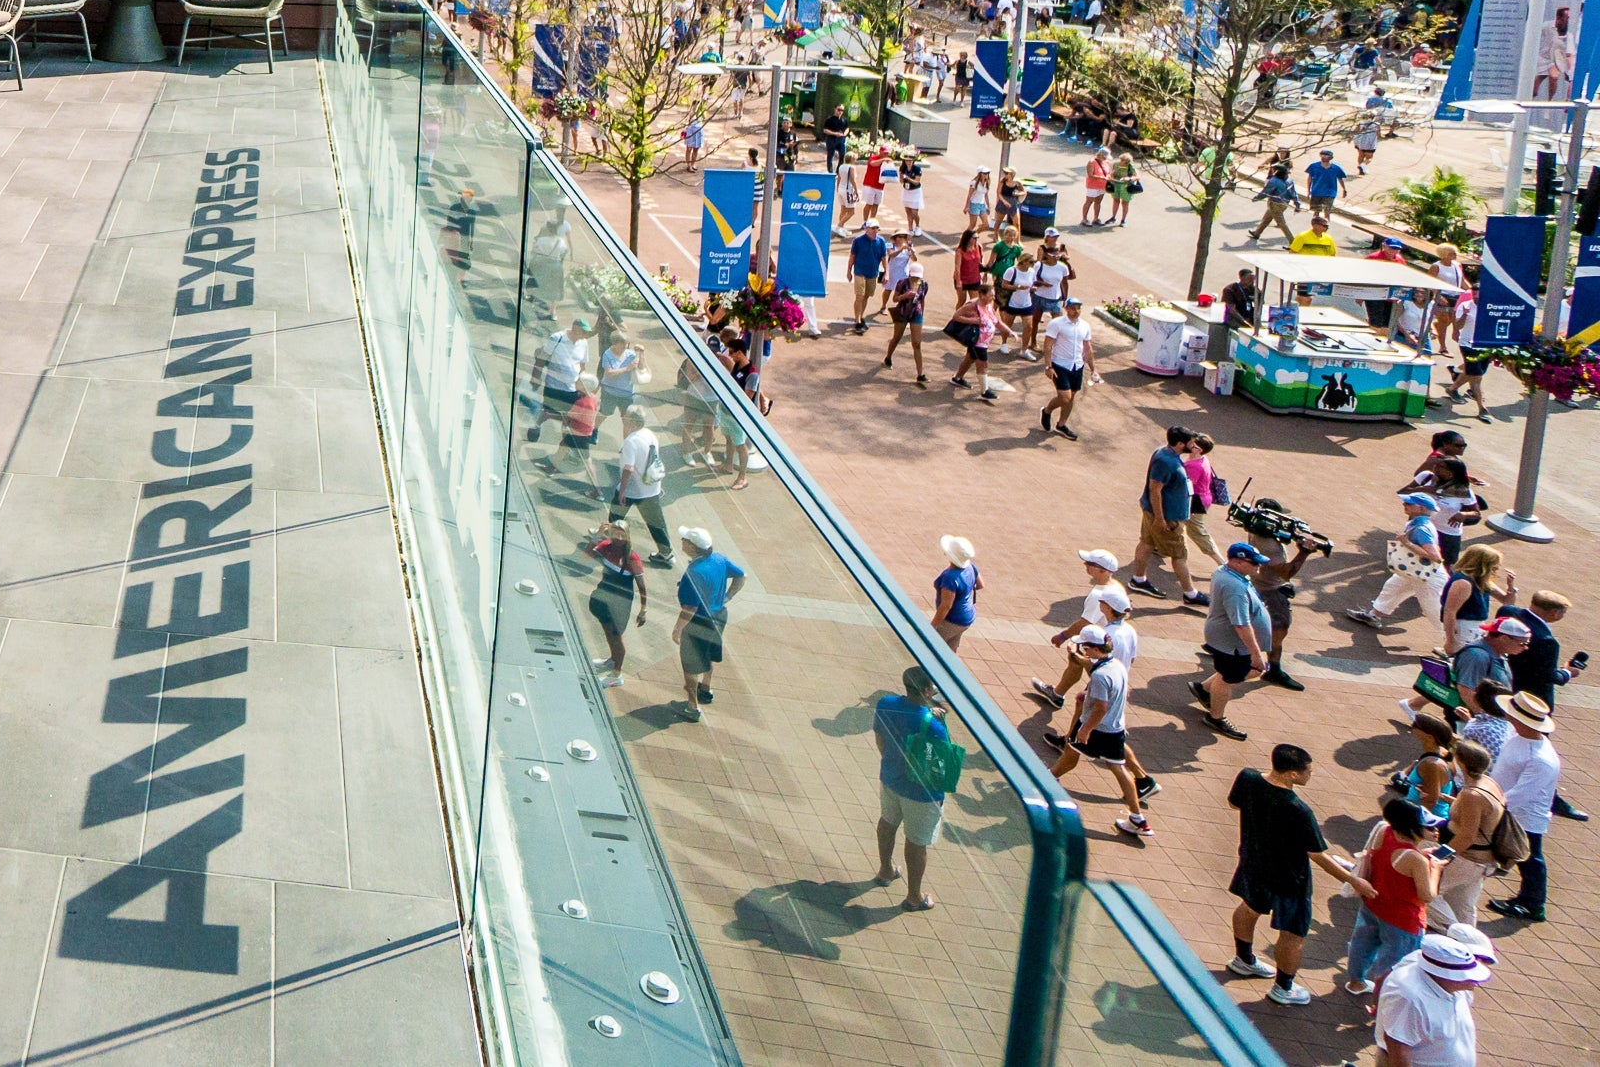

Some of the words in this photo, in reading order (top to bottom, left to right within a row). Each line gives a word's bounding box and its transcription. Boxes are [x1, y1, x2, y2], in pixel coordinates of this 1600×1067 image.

[790, 202, 802, 210] us
[802, 203, 828, 212] open
[1486, 303, 1526, 311] Download
[57, 327, 254, 976] AMERICAN
[173, 147, 260, 317] EXPRESS
